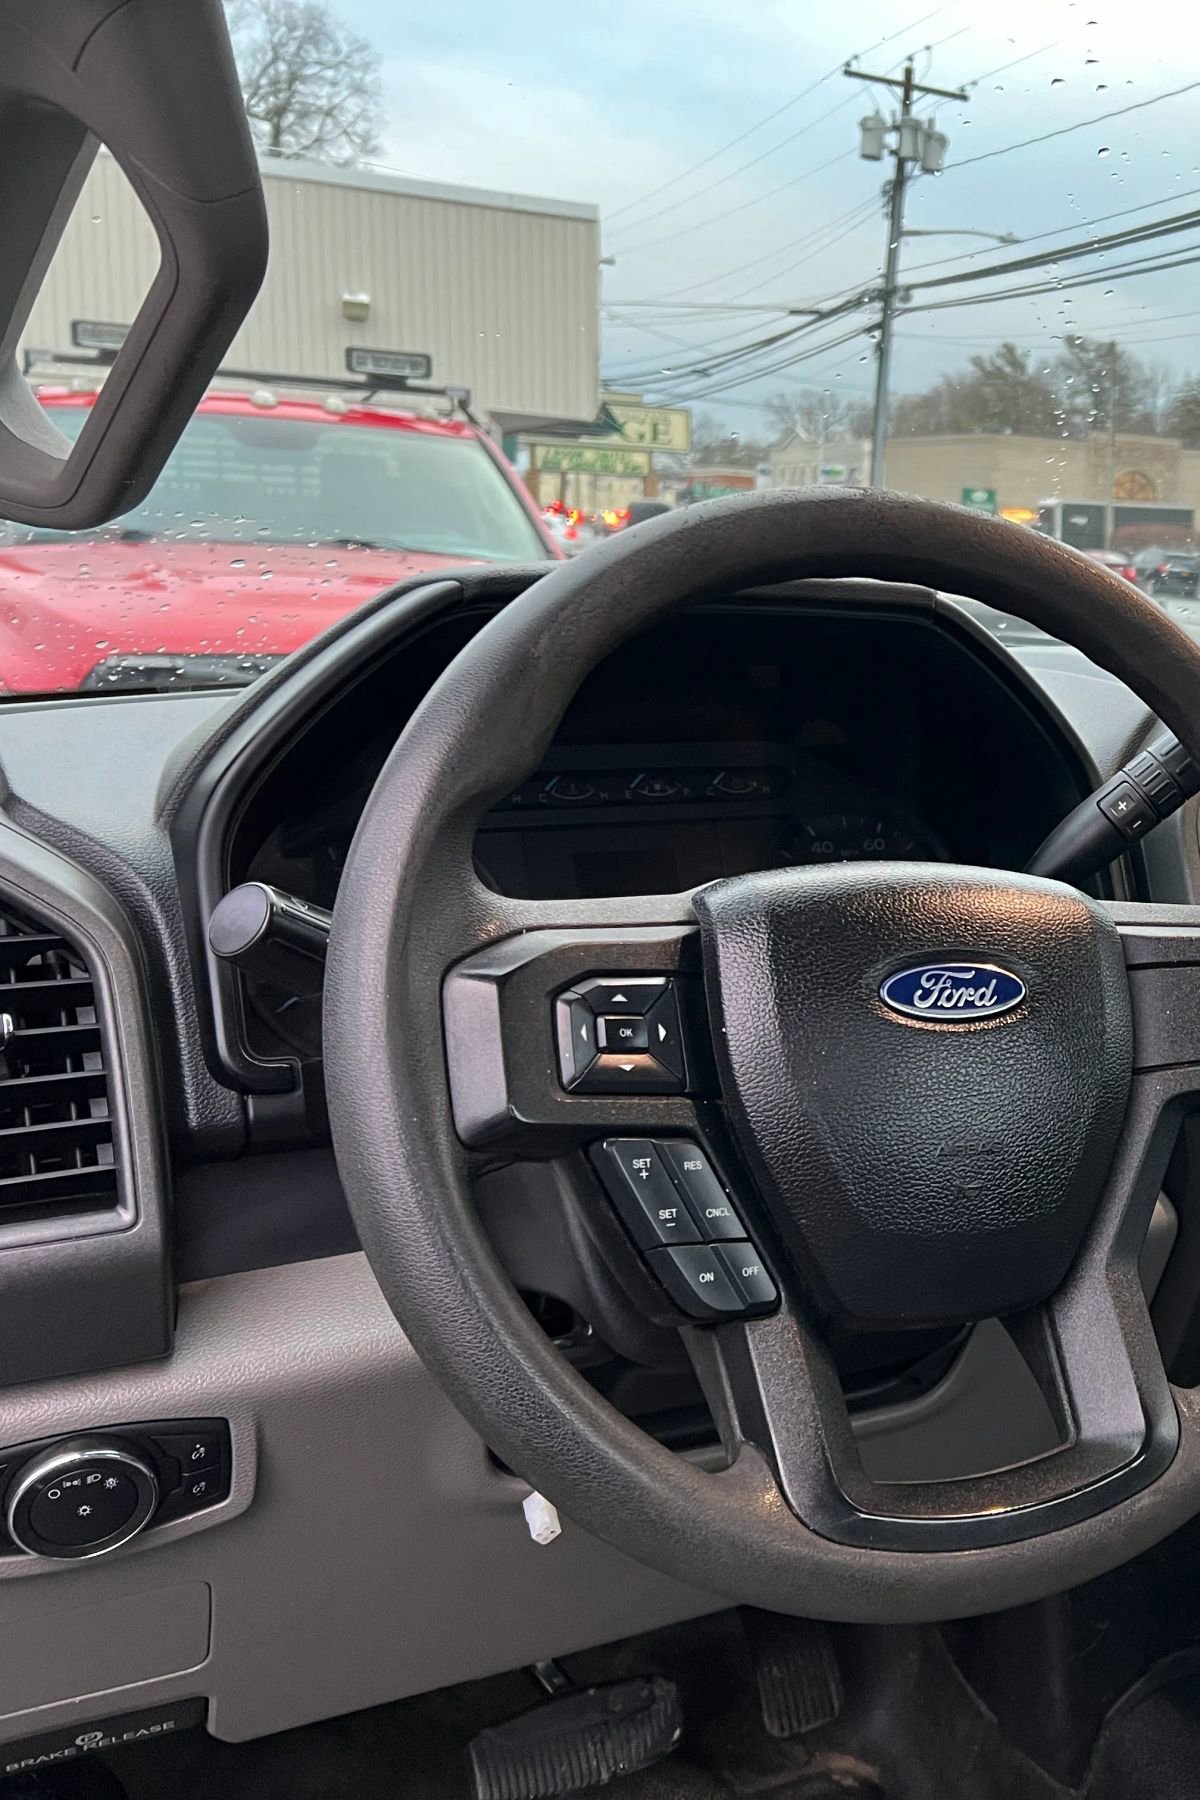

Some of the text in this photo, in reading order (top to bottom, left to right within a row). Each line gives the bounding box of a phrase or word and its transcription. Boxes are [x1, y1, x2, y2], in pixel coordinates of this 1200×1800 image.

[812, 841, 834, 855] 40
[863, 838, 886, 852] 60
[913, 970, 998, 1008] Ford
[619, 1027, 633, 1037] OK
[632, 1158, 651, 1169] SET
[684, 1160, 702, 1171] RES
[658, 1208, 677, 1220] SET
[705, 1207, 731, 1218] CNCL
[742, 1266, 759, 1277] OFF
[699, 1272, 714, 1283] ON
[5, 1720, 175, 1772] BRAKE RELEASE
